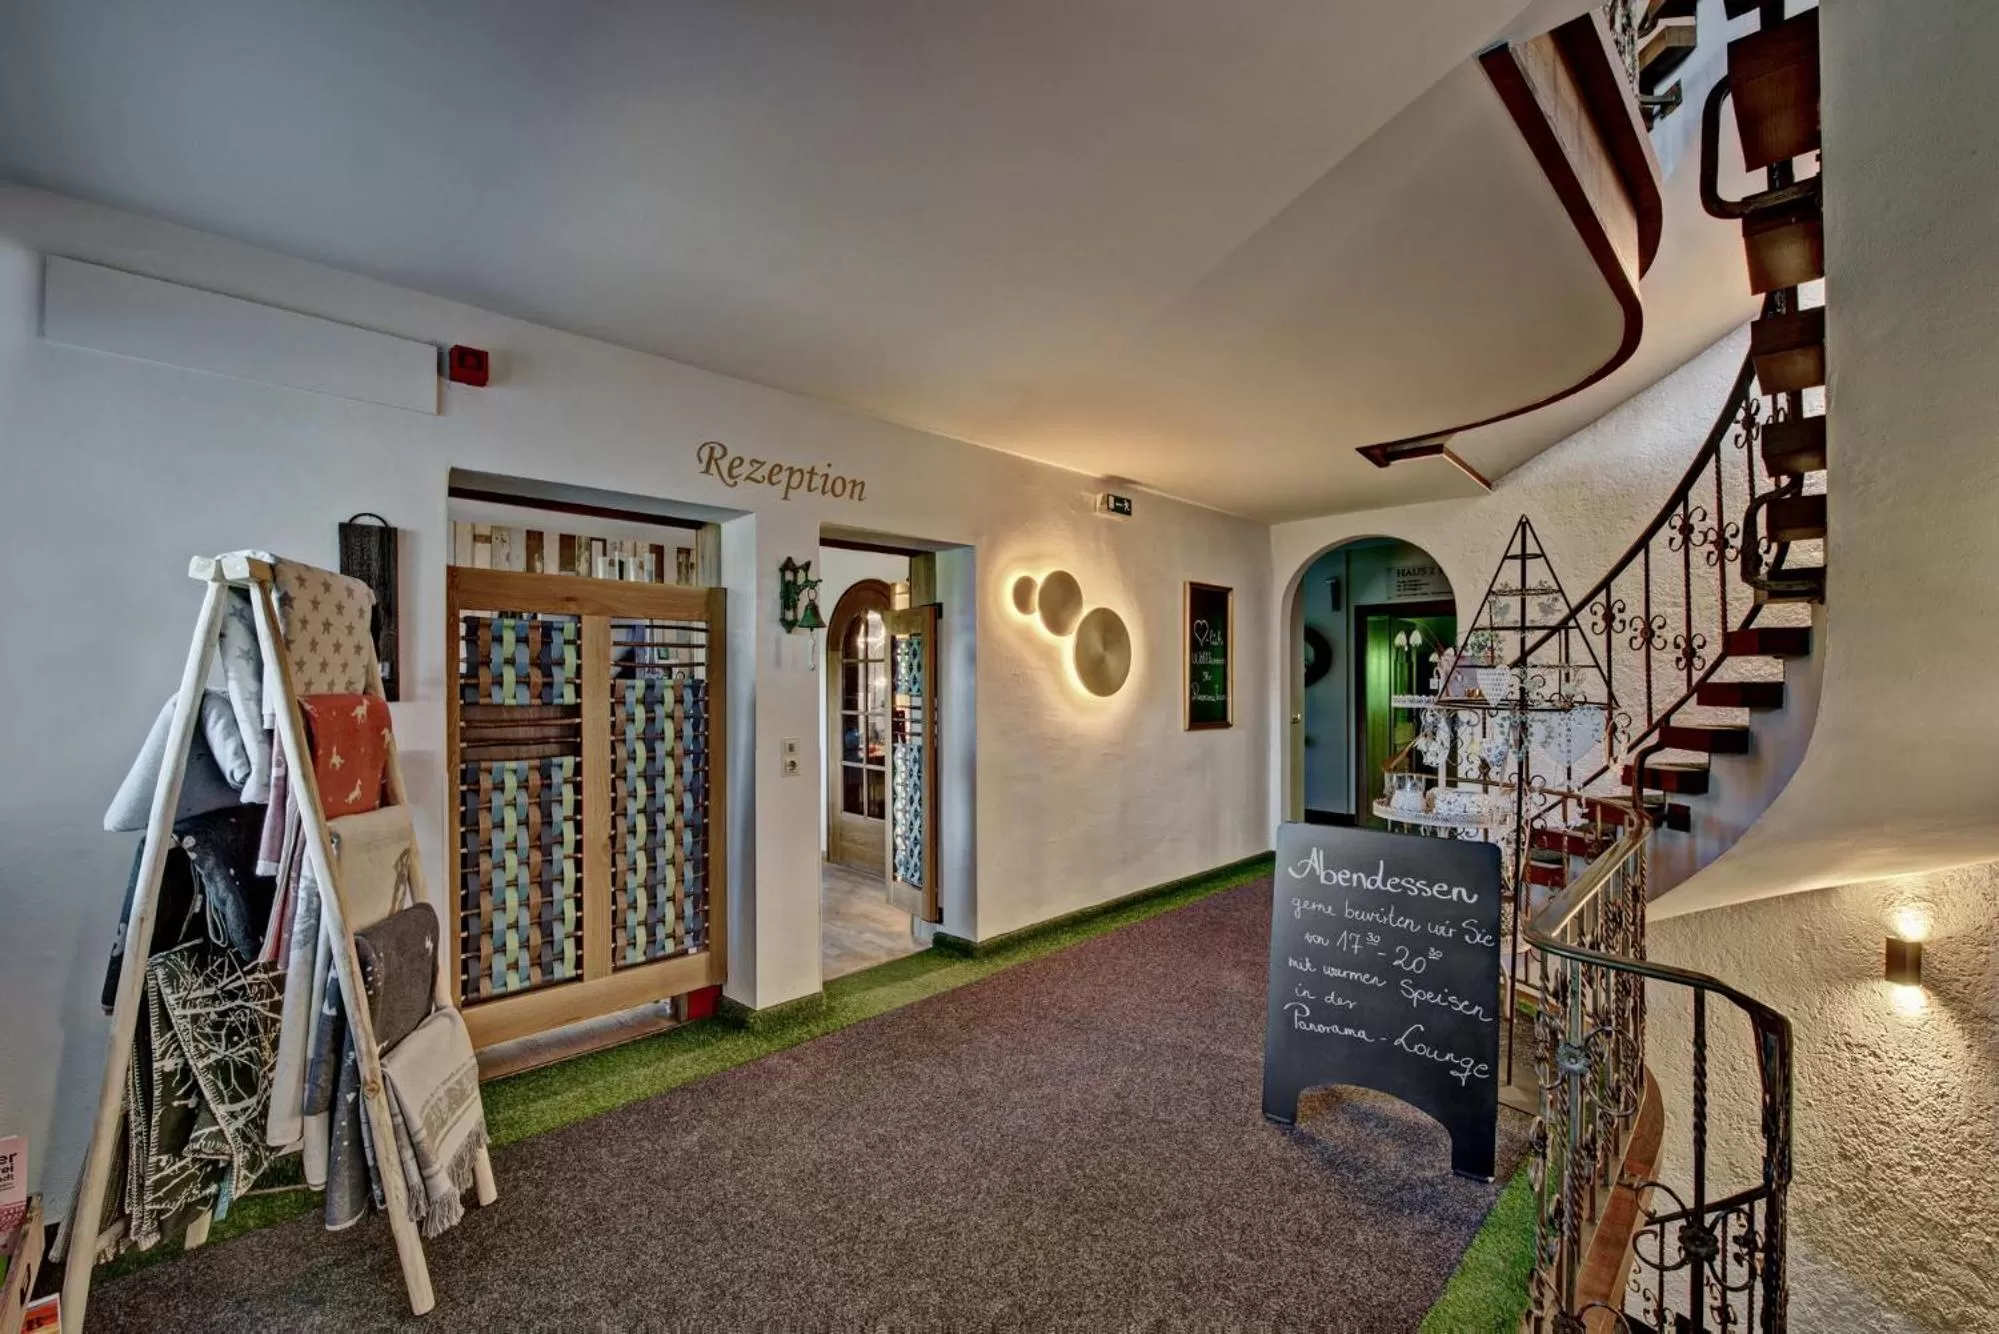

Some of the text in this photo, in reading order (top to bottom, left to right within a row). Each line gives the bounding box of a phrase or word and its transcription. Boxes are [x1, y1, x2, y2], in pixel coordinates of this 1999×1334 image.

[697, 441, 867, 502] Rezeption
[1287, 847, 1479, 904] Abendessen
[1461, 918, 1495, 947] Sie
[1294, 983, 1356, 1009] in der
[1400, 978, 1493, 1022] Speisen
[1283, 1002, 1376, 1043] Panorama
[1393, 1024, 1490, 1087] Lounge
